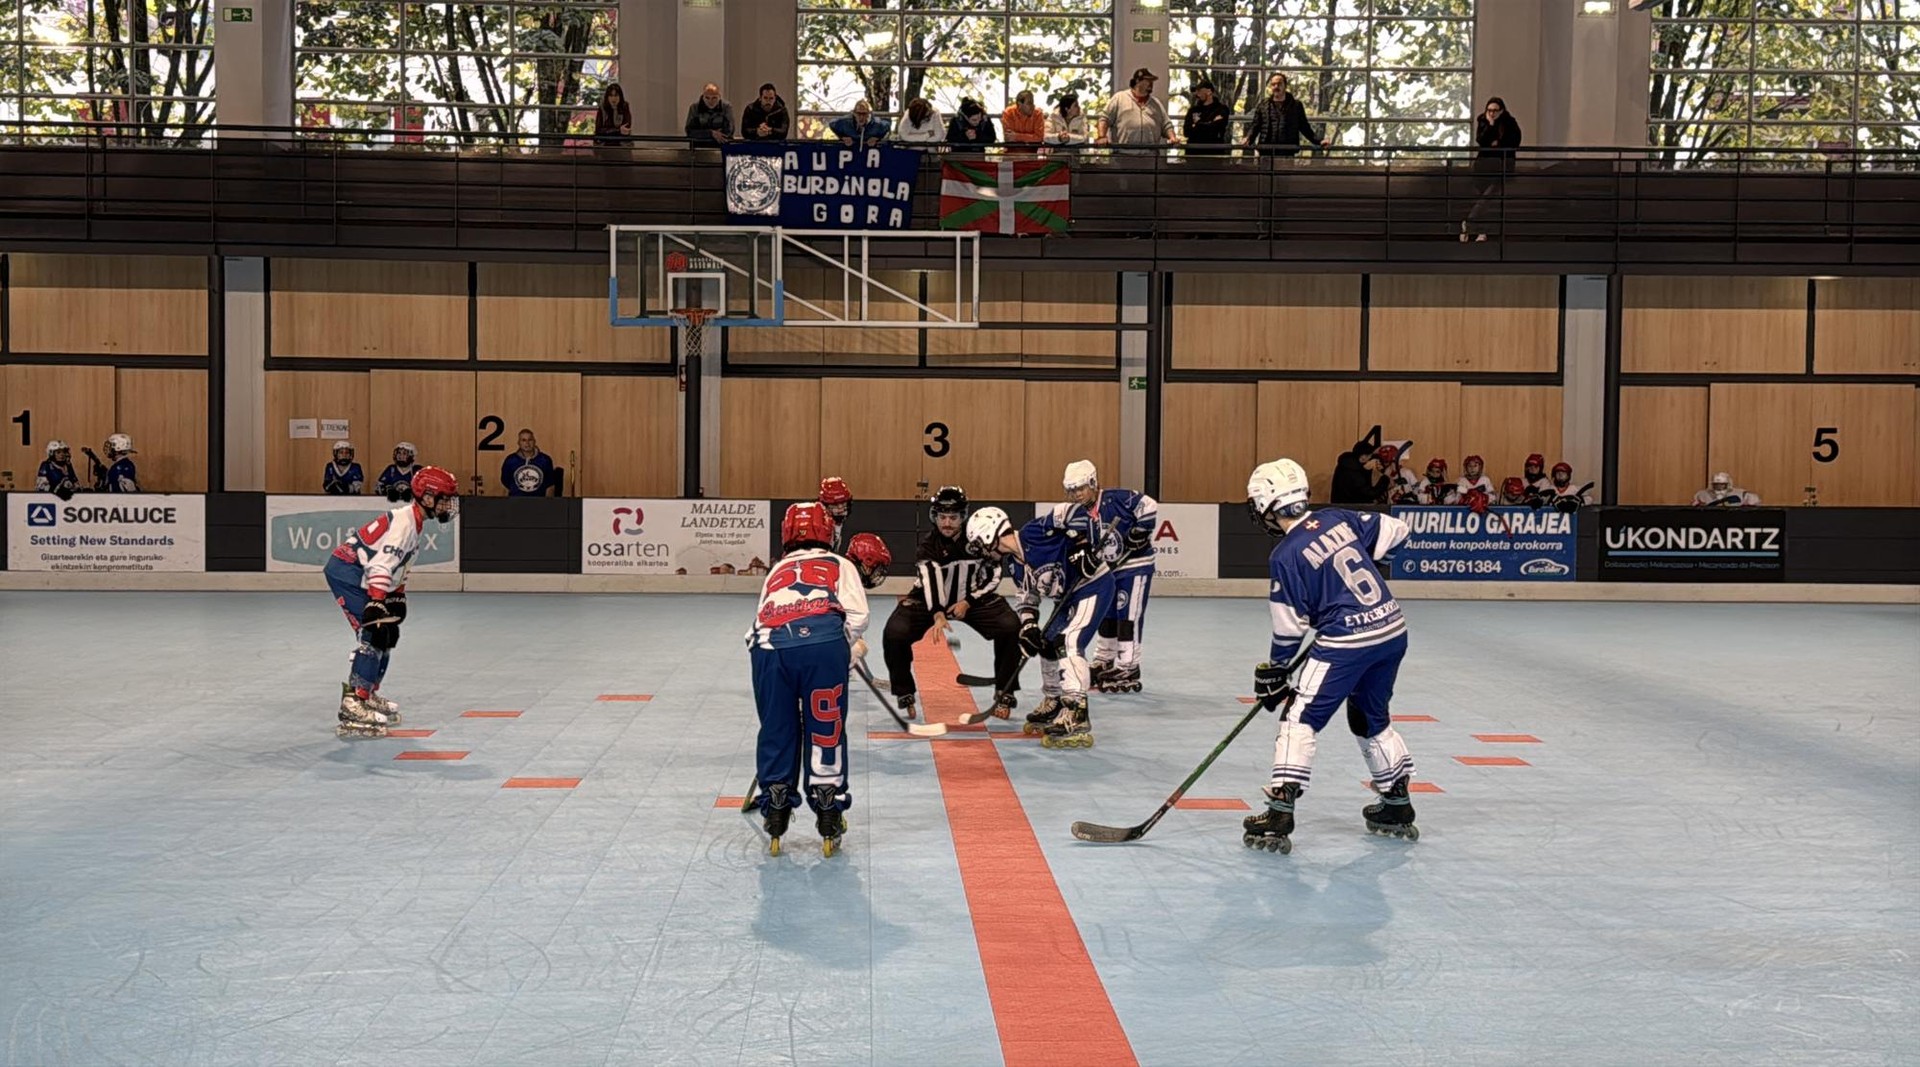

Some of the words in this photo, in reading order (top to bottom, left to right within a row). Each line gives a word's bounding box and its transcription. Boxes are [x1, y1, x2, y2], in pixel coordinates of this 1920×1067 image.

[784, 148, 880, 171] AUPA
[813, 203, 903, 228] GORA
[12, 410, 31, 446] 1
[478, 415, 505, 451] 2
[923, 422, 950, 458] 3
[1812, 427, 1840, 463] 5
[63, 506, 176, 524] SORALUCE
[690, 503, 756, 515] MAIALDE
[680, 517, 765, 529] LANDETXEA
[1399, 511, 1480, 534] MURILLO
[1485, 512, 1572, 535] GARAJEA
[30, 535, 76, 547] Setting
[79, 535, 106, 546] New
[109, 535, 174, 546] Standards
[587, 541, 669, 557] osarten
[1404, 539, 1446, 549] Autoen
[1450, 539, 1510, 552] konpoketa
[1513, 540, 1563, 550] orokorra
[40, 553, 94, 561] Gizartearekin
[95, 553, 108, 561] eta
[109, 554, 127, 562] gure
[587, 559, 634, 567] kooperatiba
[636, 559, 669, 567] elkartea
[1420, 560, 1502, 573] 943761384
[1332, 546, 1382, 606] 6
